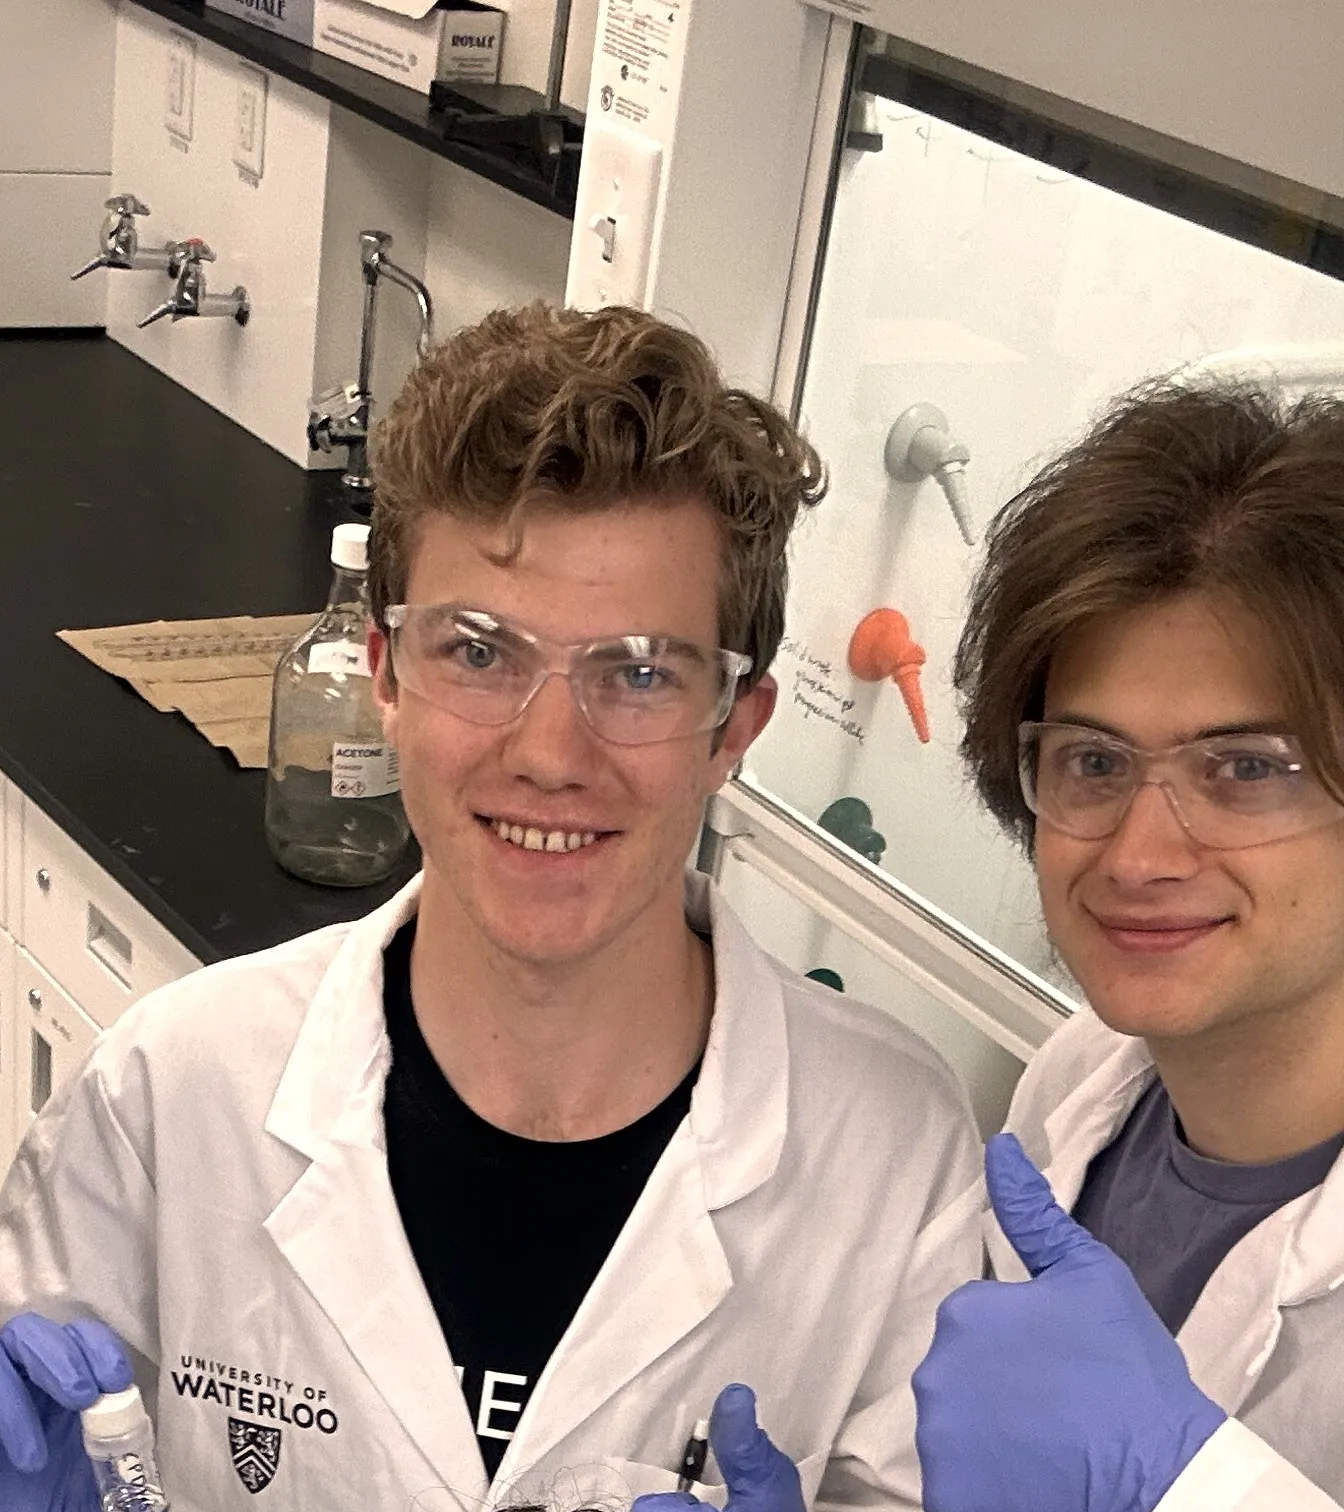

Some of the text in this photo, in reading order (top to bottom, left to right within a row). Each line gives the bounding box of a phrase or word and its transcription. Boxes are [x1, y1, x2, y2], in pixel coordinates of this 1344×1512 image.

[335, 747, 383, 758] ACETONE
[181, 1355, 327, 1402] UNIVERSITY OF
[170, 1370, 339, 1435] WATERLOO
